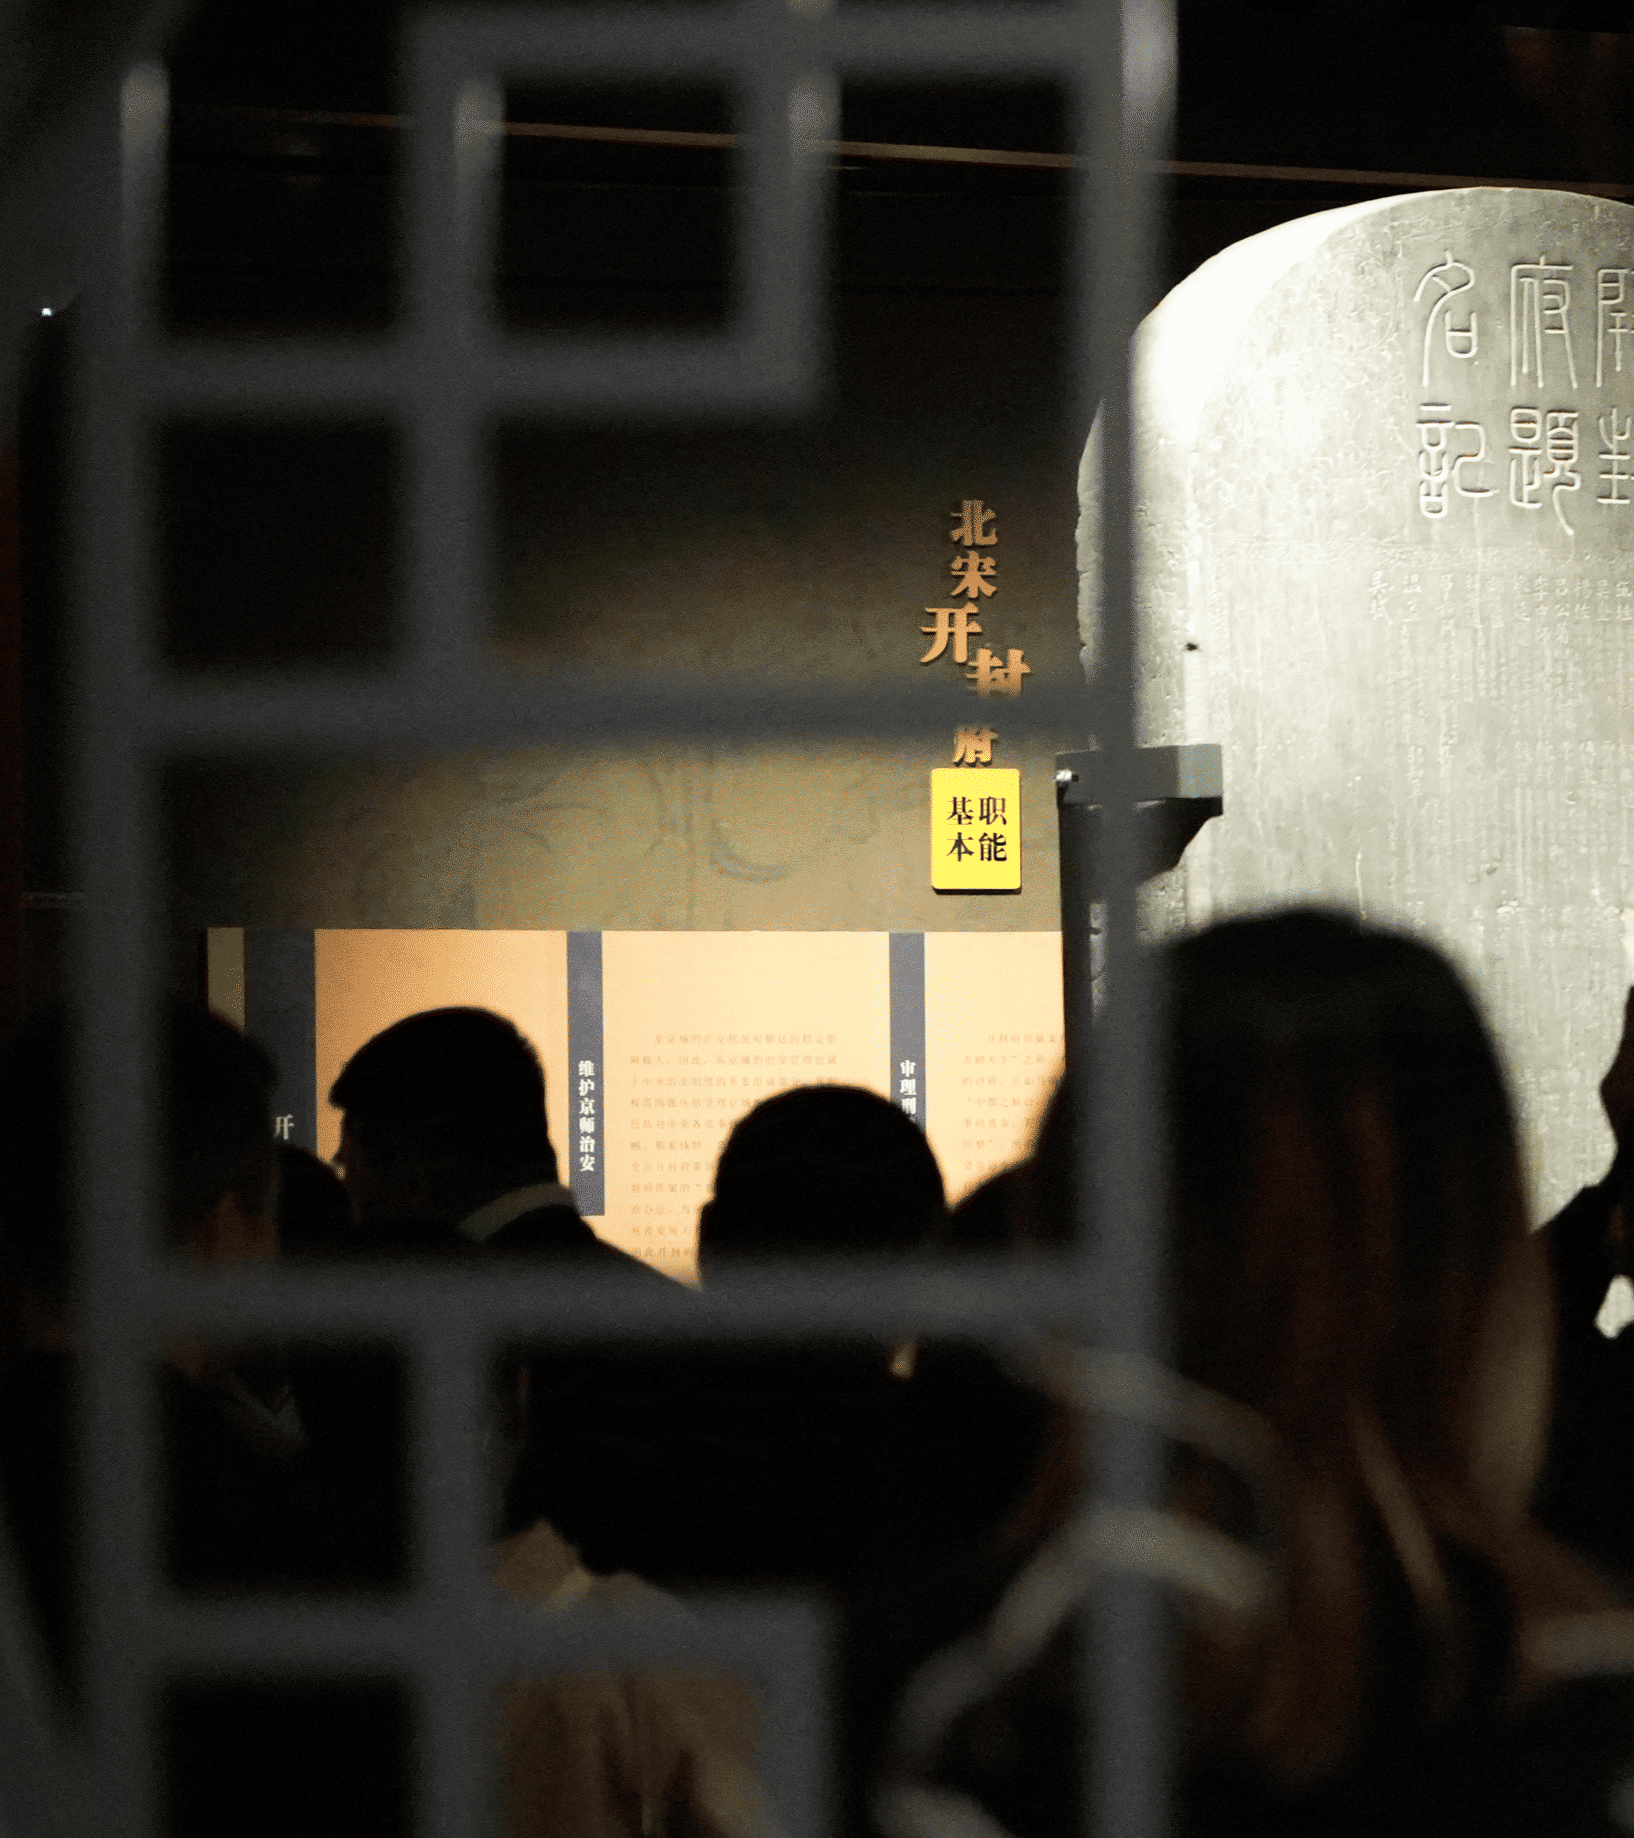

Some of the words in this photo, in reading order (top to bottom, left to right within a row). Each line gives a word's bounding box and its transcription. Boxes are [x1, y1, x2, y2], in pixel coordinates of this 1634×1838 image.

[946, 796, 974, 862] 基本
[978, 796, 1008, 862] 职能
[578, 1060, 596, 1172] 维护京师治安
[899, 1059, 917, 1115] 审理刑
